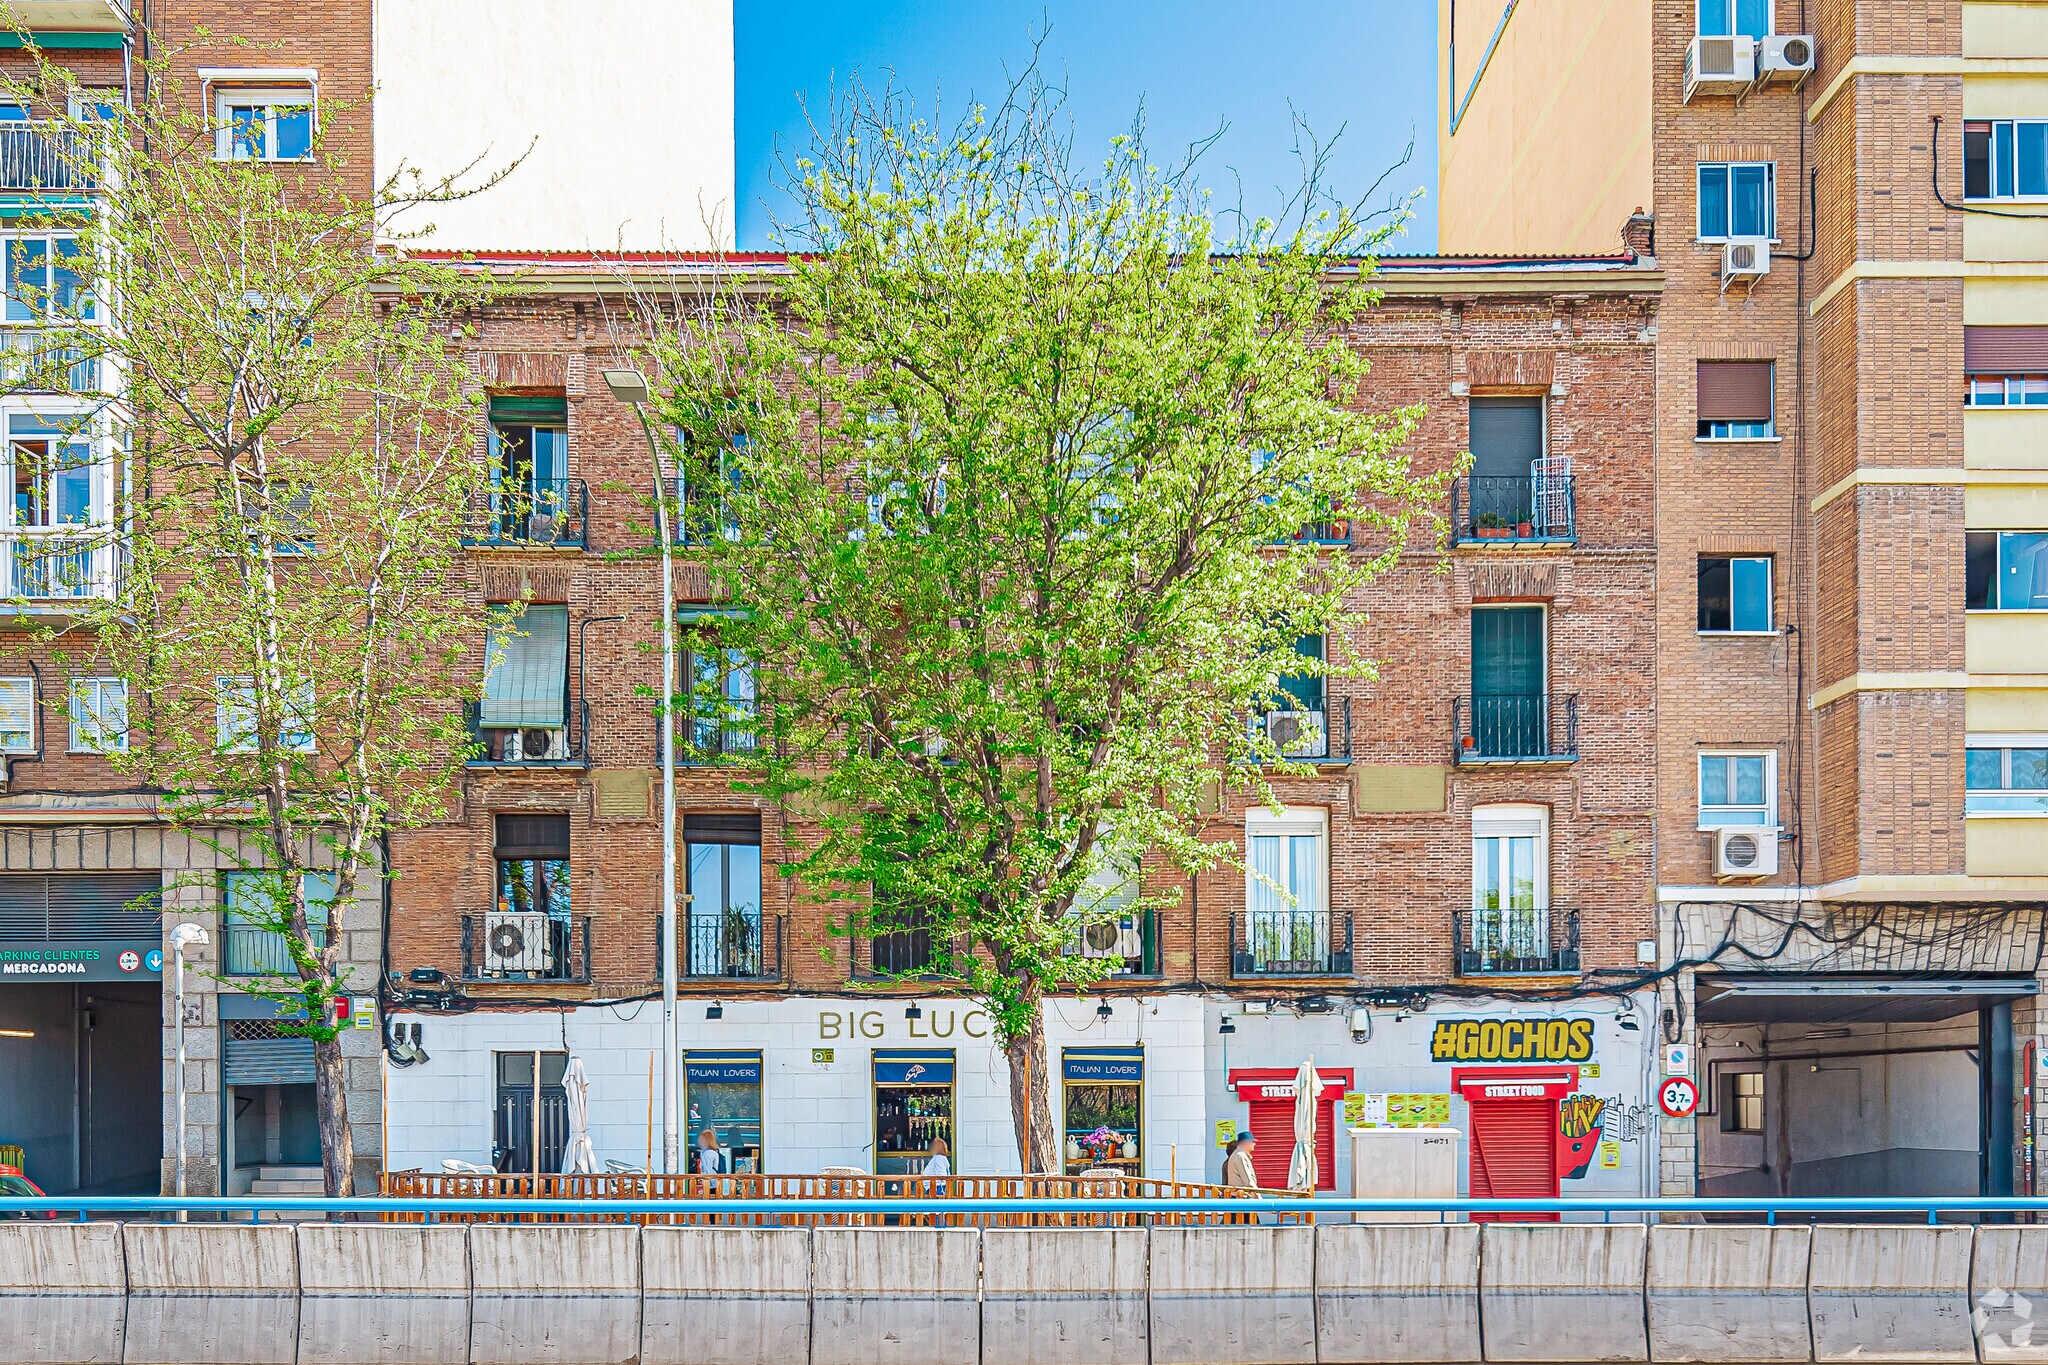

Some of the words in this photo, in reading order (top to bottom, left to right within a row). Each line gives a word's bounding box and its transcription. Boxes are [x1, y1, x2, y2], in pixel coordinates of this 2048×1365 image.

[44, 950, 100, 961] CLIENTES
[3, 962, 86, 974] MERCADONA
[819, 1011, 885, 1039] BIG
[1431, 1019, 1593, 1061] #GOCHOS
[688, 1068, 720, 1077] ITALIAN
[723, 1069, 756, 1077] LOVERS
[1070, 1065, 1101, 1074] ITALIAN
[1105, 1066, 1137, 1075] LOVERS
[1484, 1085, 1521, 1098] STREET
[1522, 1085, 1545, 1097] FOOD
